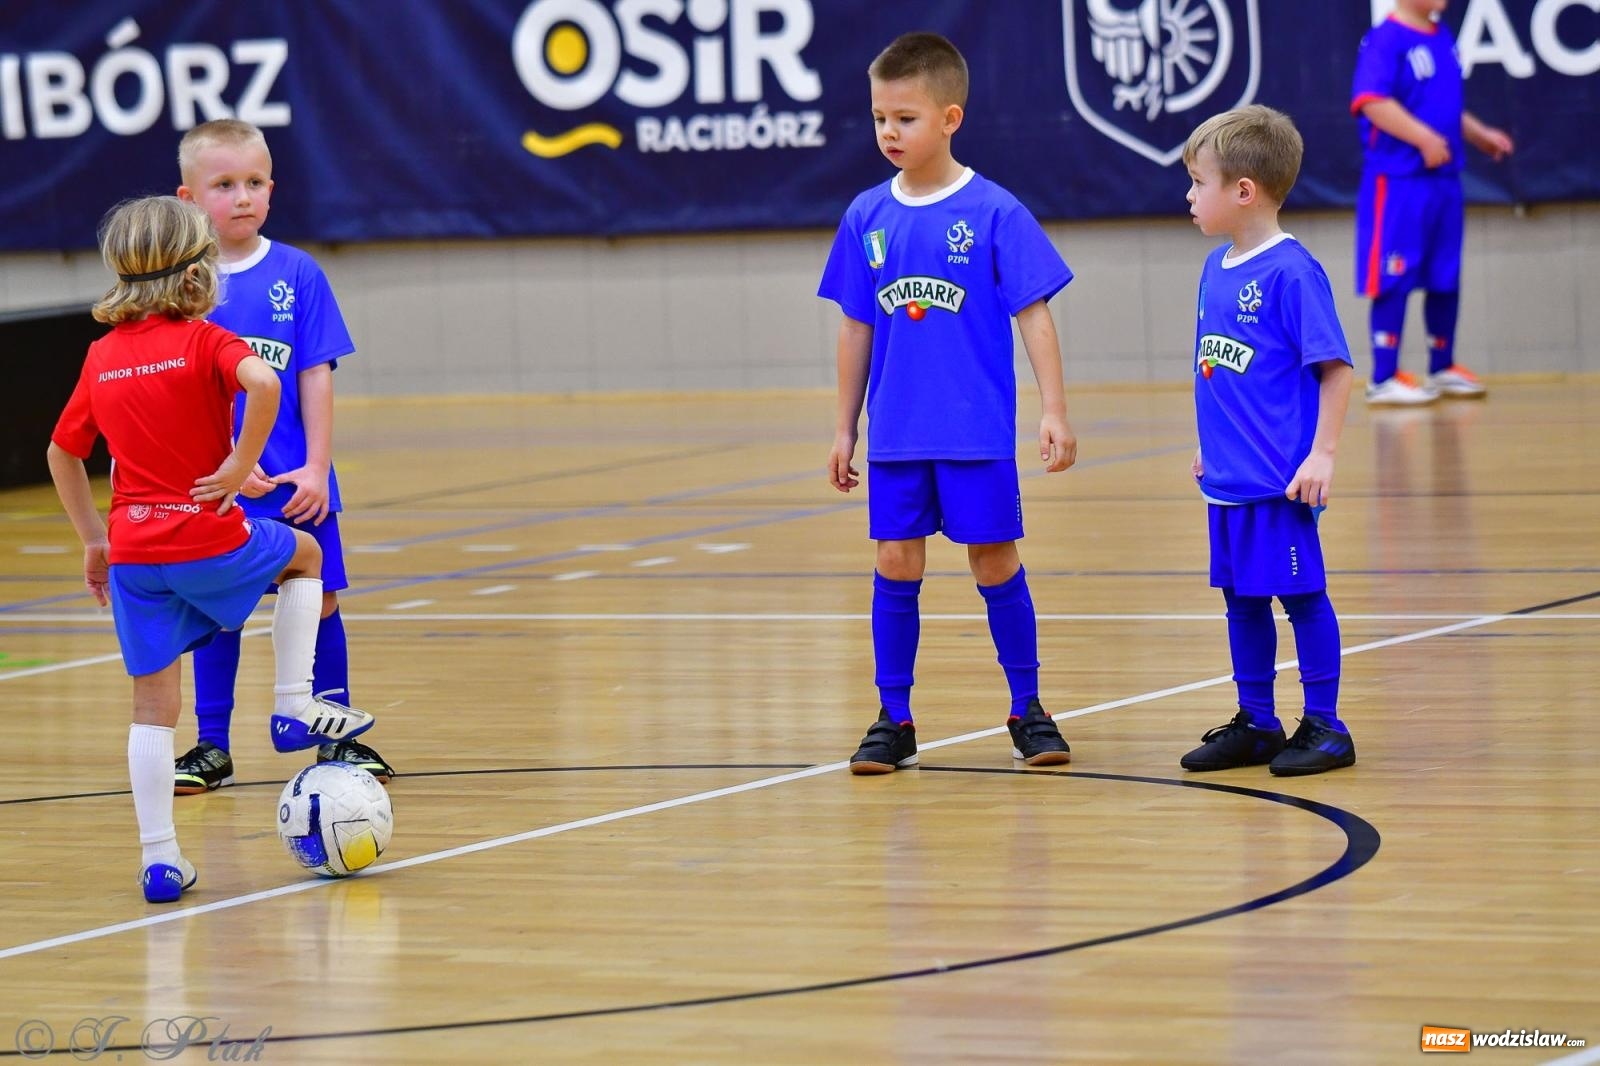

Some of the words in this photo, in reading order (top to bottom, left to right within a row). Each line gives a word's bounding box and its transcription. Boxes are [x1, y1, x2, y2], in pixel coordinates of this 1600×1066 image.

[1370, 0, 1600, 79] AC
[511, 0, 823, 111] OSiR
[635, 103, 827, 153] RACIBÓRZ
[947, 255, 970, 265] PZPN
[272, 313, 294, 322] PZPN
[1236, 314, 1259, 324] PZPN
[98, 368, 133, 383] JUNIOR
[135, 357, 186, 376] TRENING
[1290, 546, 1298, 576] KIPSTA
